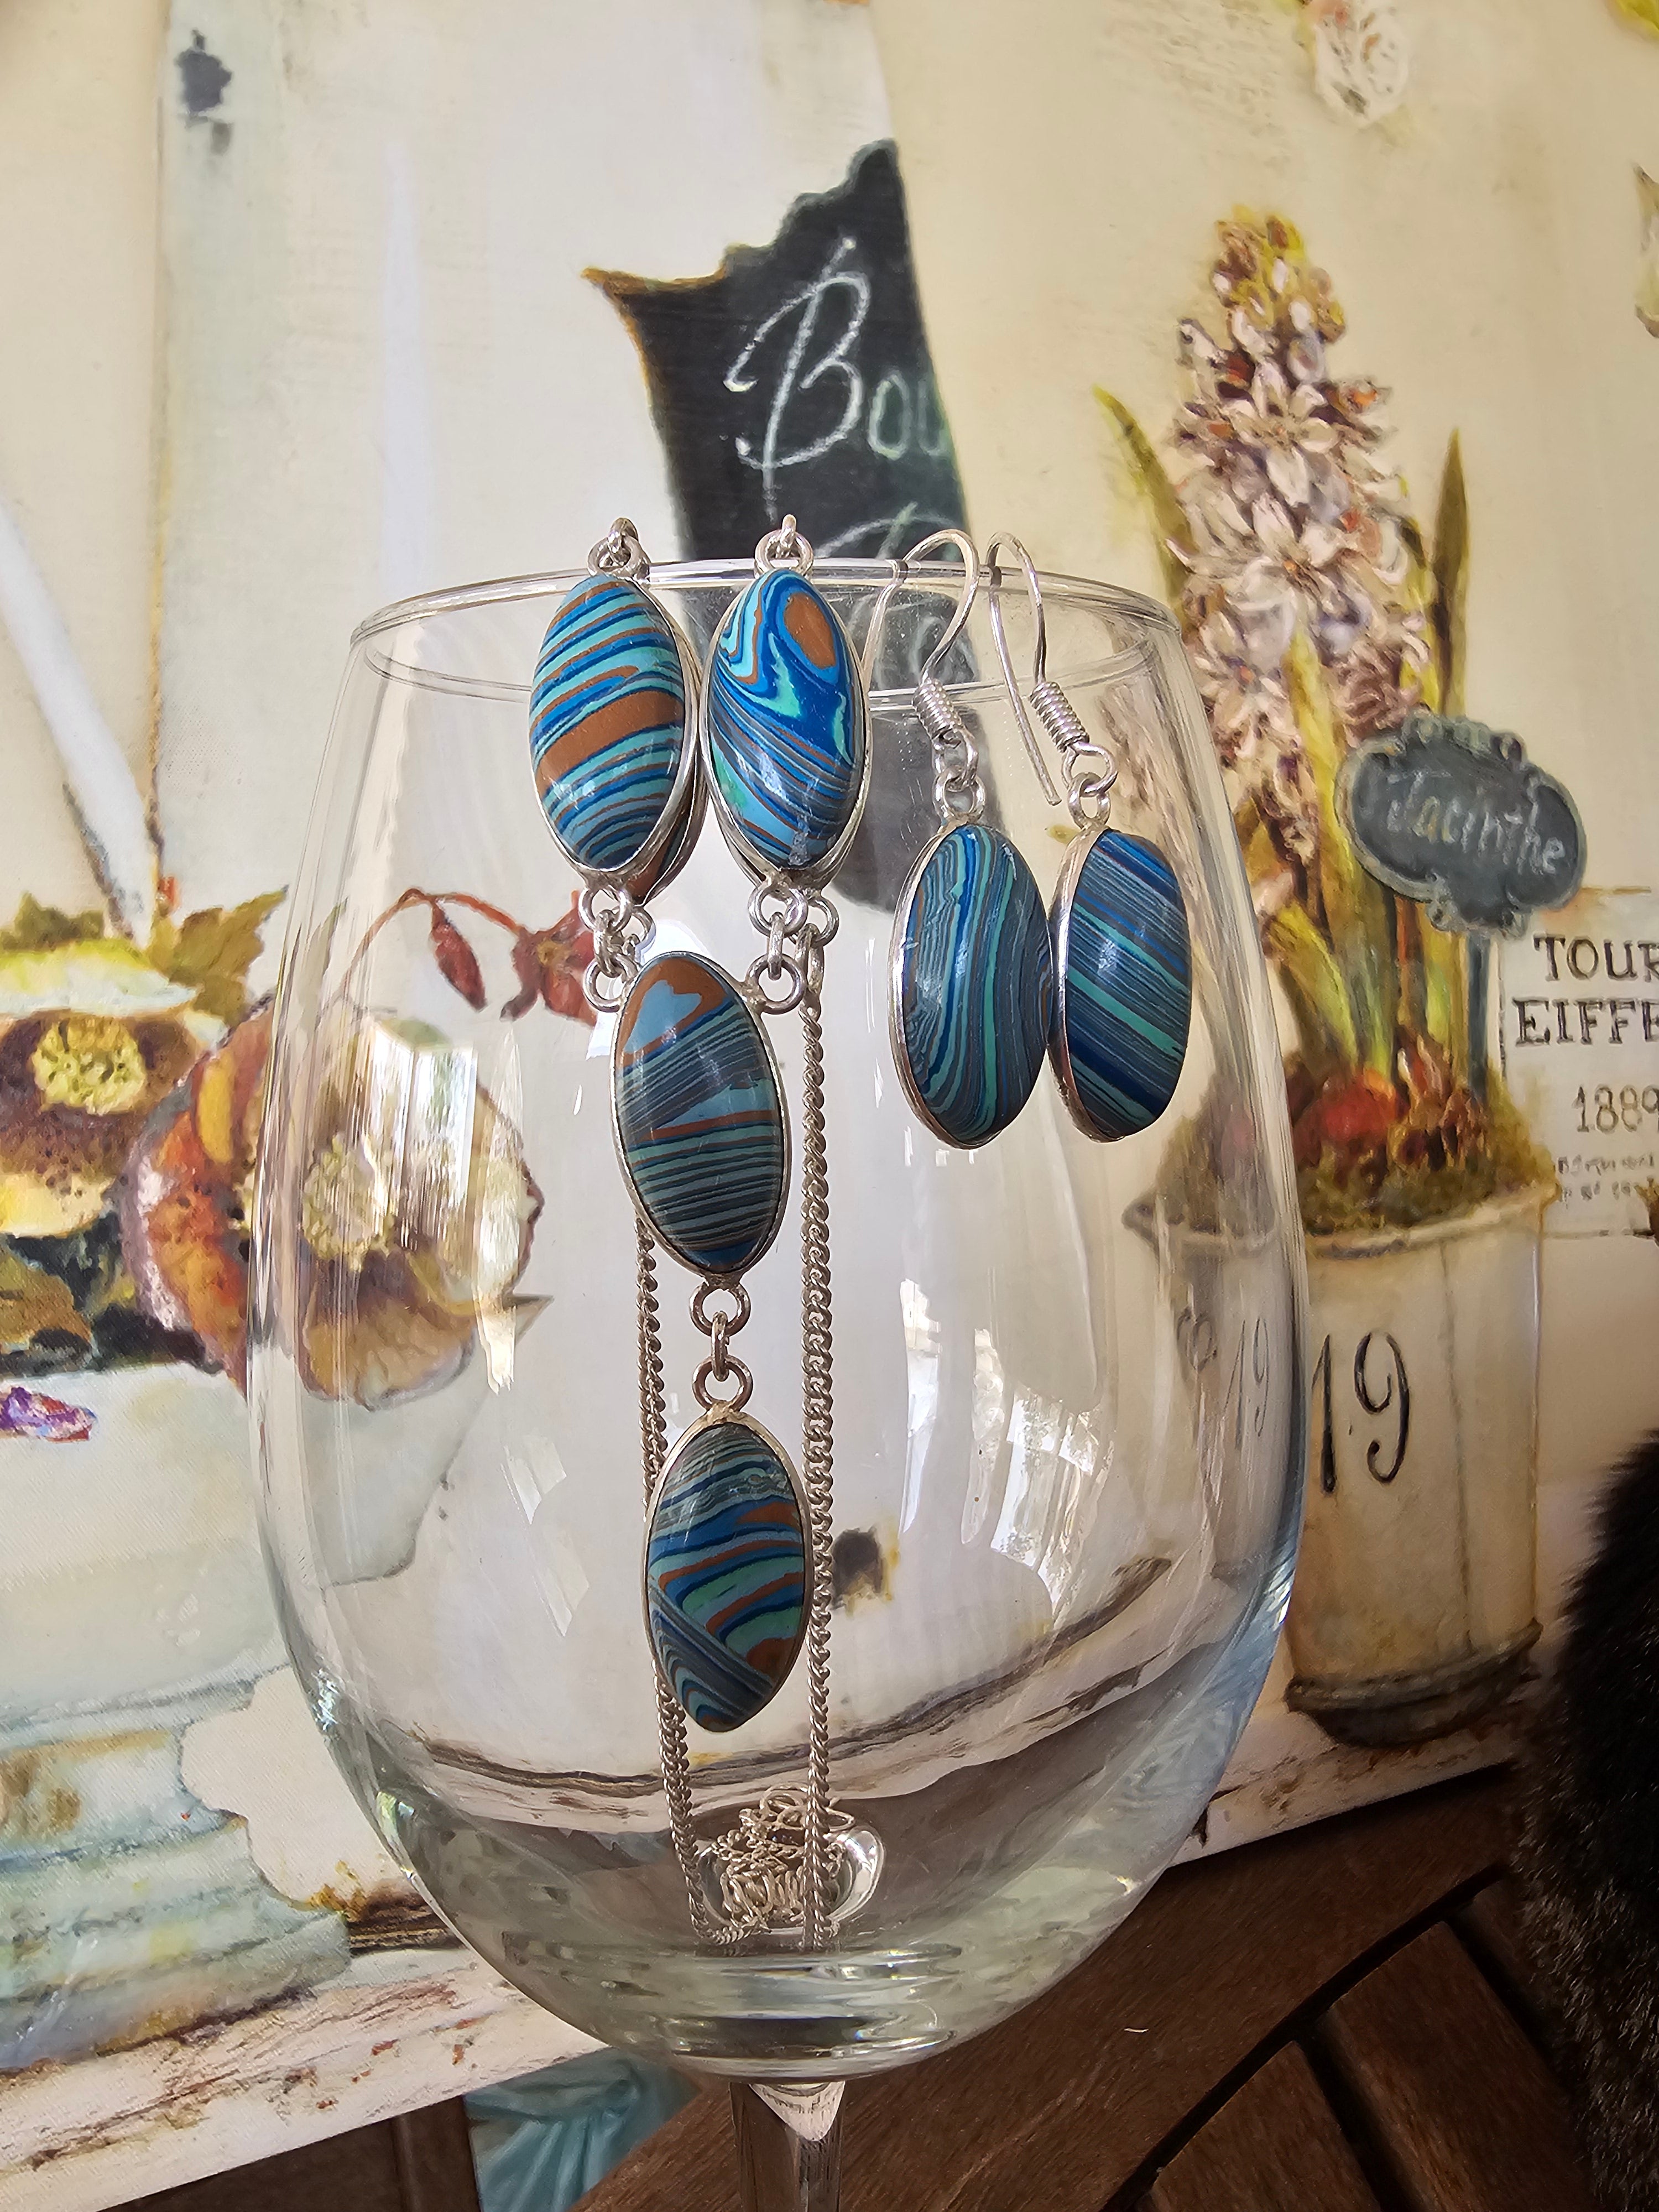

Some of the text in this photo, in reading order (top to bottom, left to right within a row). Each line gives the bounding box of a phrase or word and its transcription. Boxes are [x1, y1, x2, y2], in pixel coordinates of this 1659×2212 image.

[1533, 932, 1658, 983] TOUR
[1572, 1084, 1658, 1134] 1889
[1311, 1332, 1410, 1495] 19
